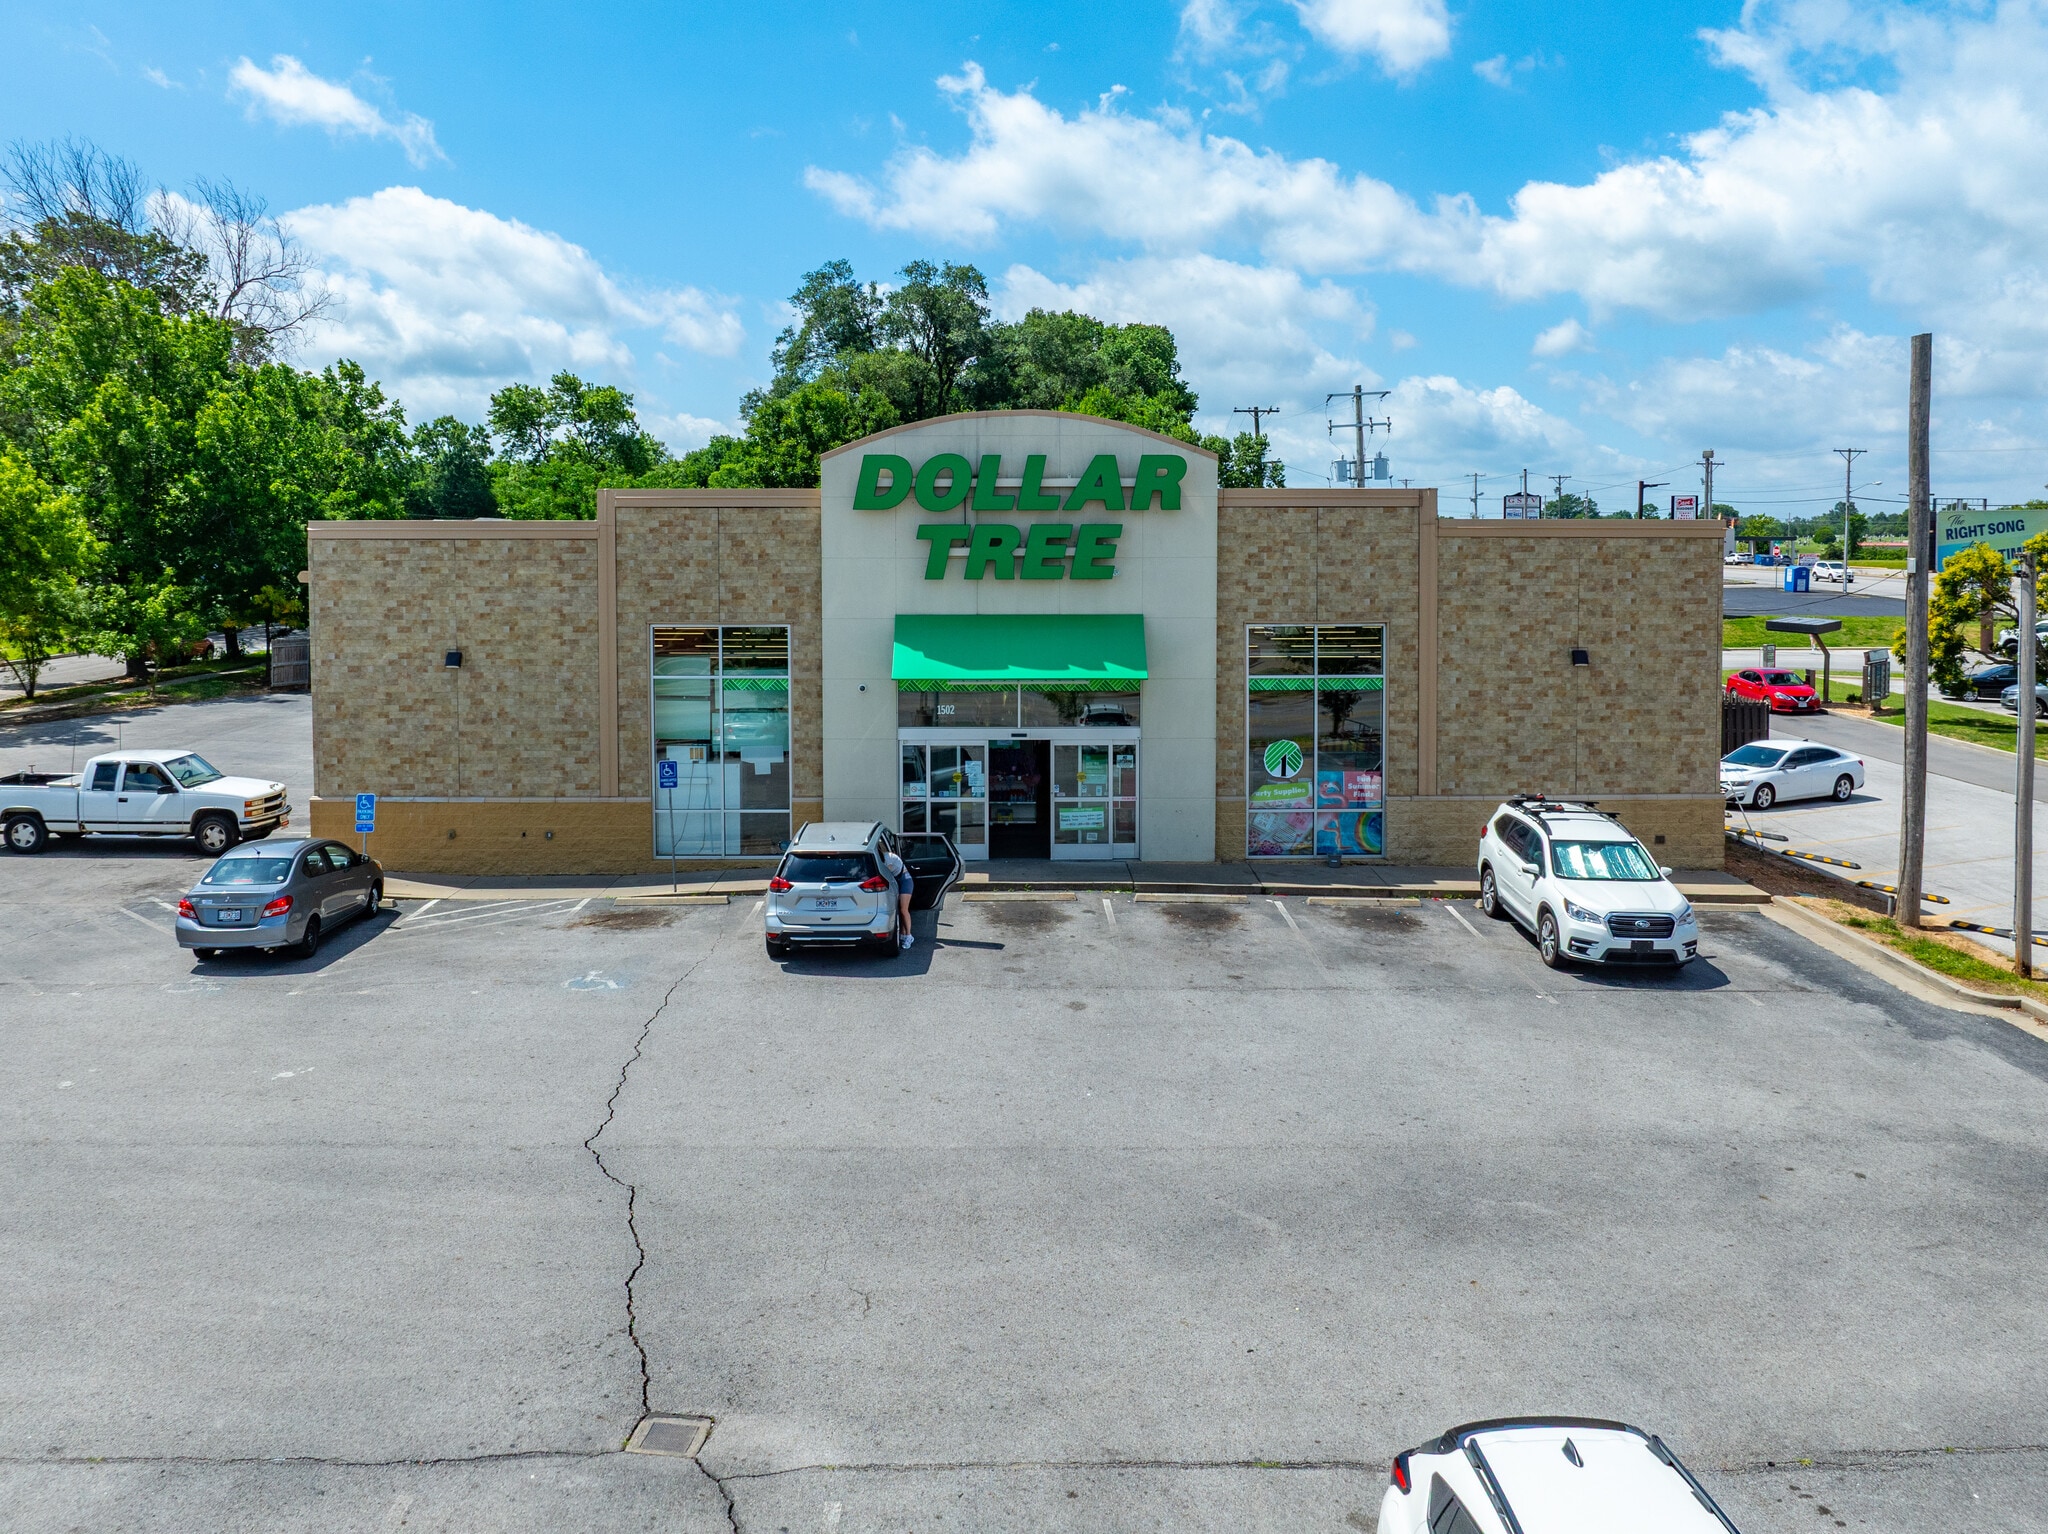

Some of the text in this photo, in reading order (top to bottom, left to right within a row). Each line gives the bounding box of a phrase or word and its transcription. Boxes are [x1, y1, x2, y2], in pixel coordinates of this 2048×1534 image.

[853, 453, 1187, 512] DOLLAR
[1947, 514, 1966, 527] The
[1945, 519, 2025, 540] RIGHT SONG
[916, 524, 1123, 580] TREE
[1997, 546, 2028, 560] TIM
[937, 704, 955, 715] 1502
[1356, 775, 1371, 783] Fun
[1273, 786, 1306, 796] Supplies
